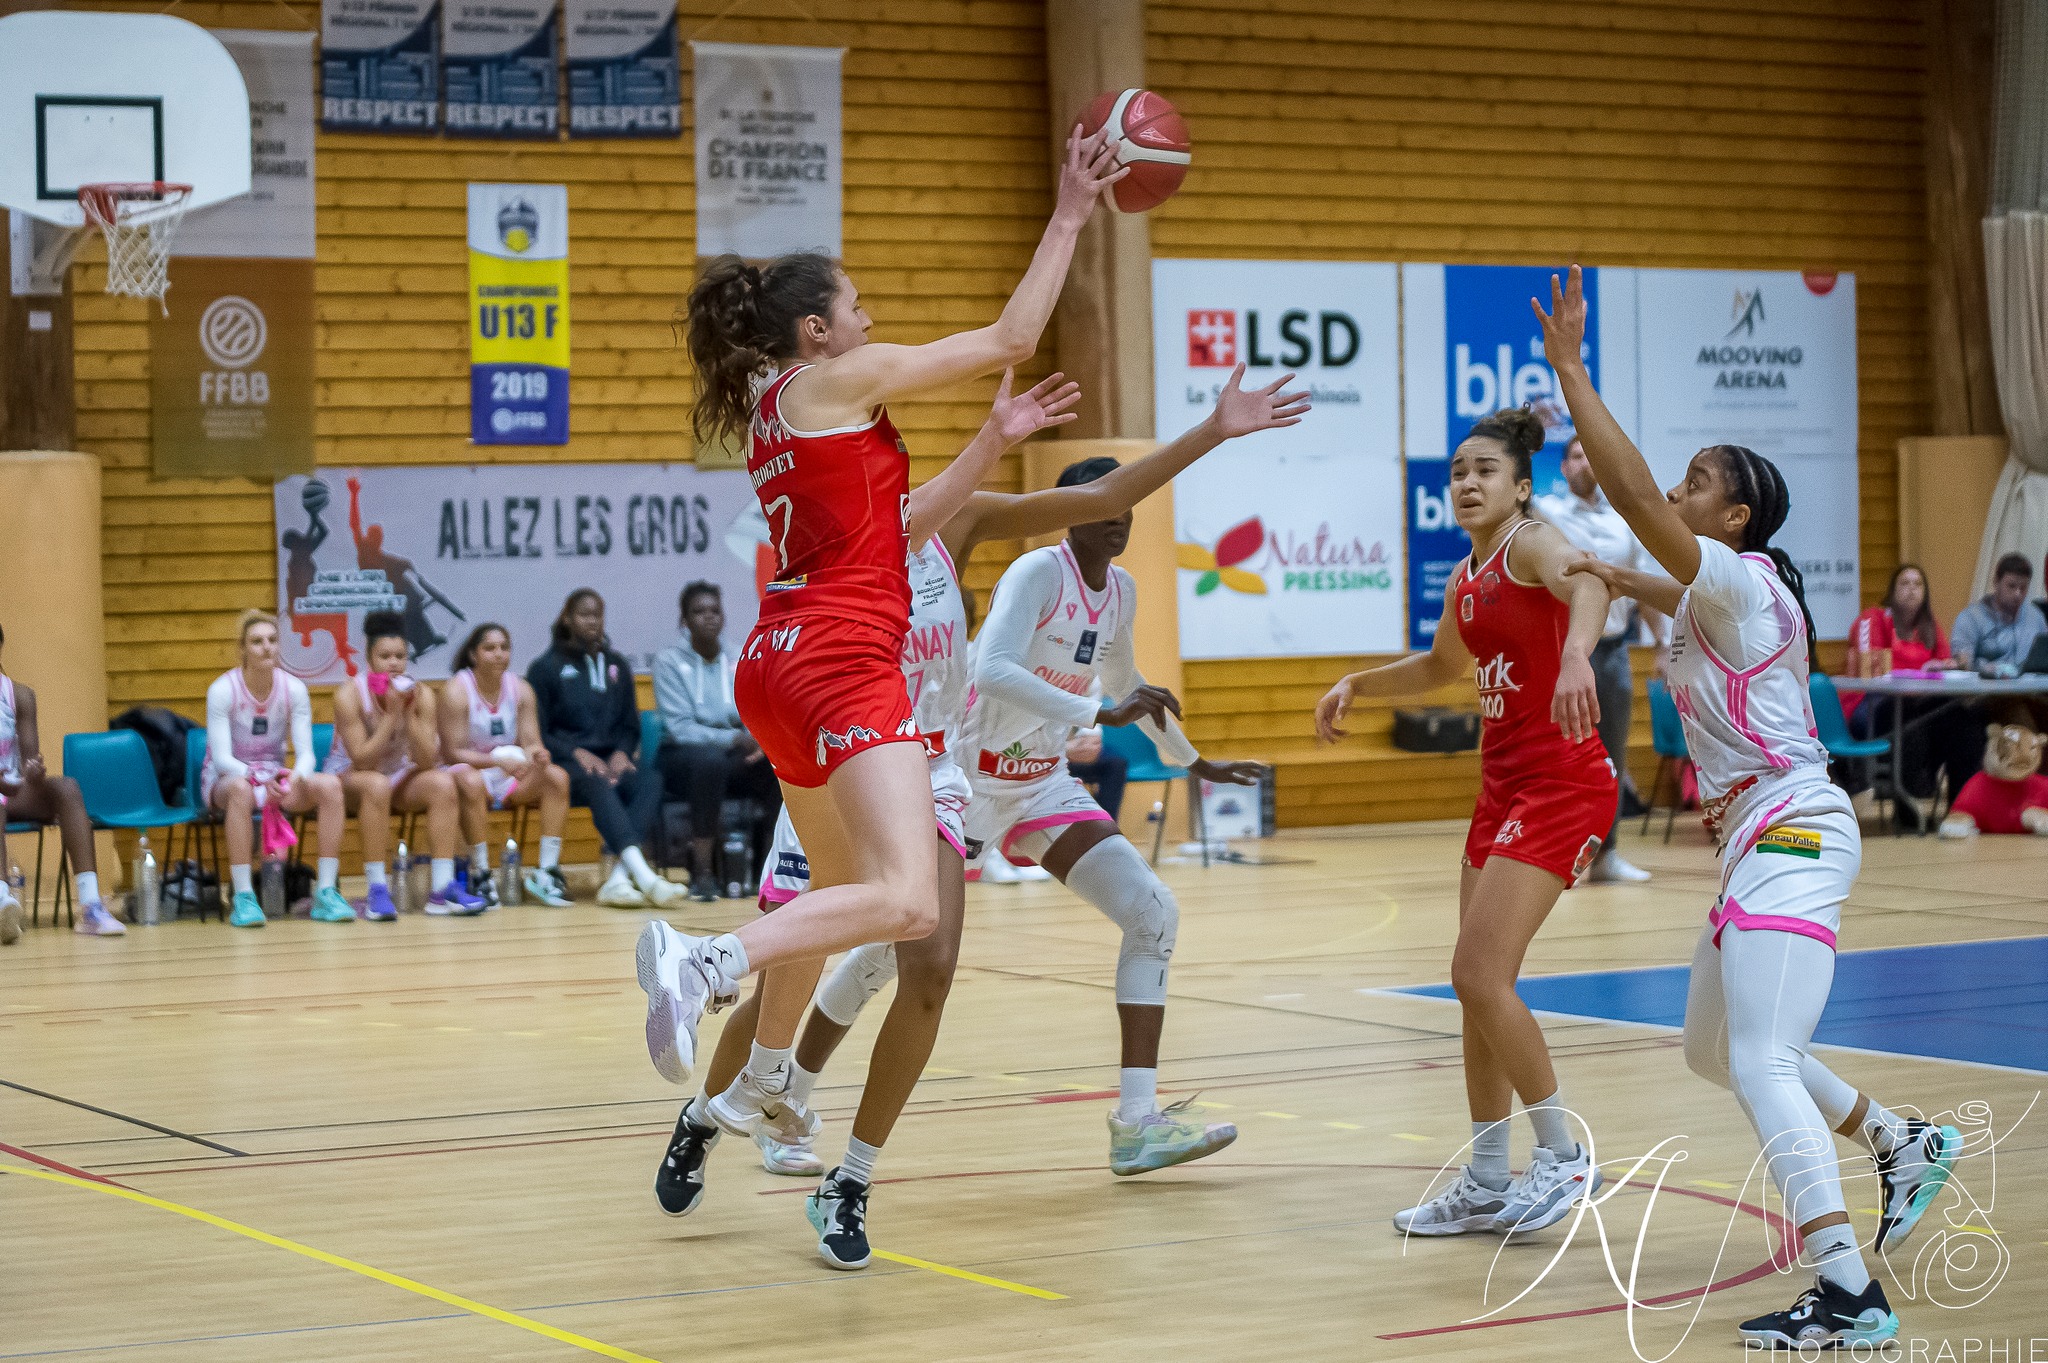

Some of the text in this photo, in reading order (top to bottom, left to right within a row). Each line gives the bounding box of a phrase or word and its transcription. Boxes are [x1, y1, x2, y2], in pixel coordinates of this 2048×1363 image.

[323, 97, 439, 125] RESPECT
[446, 103, 559, 130] RESPECT
[571, 104, 680, 130] RESPECT
[708, 138, 828, 160] CHAMPION
[708, 159, 827, 181] DE FRANCE
[479, 303, 560, 340] U13 F
[1246, 309, 1361, 369] LSD
[1697, 346, 1804, 366] MOOVING
[199, 371, 270, 405] FFBB
[491, 371, 549, 400] 2019
[1714, 370, 1788, 390] ARENA
[437, 493, 710, 560] ALLEZ LES GROS
[765, 494, 794, 572] 7
[1260, 521, 1390, 571] Natura
[1284, 570, 1391, 592] PRESSING
